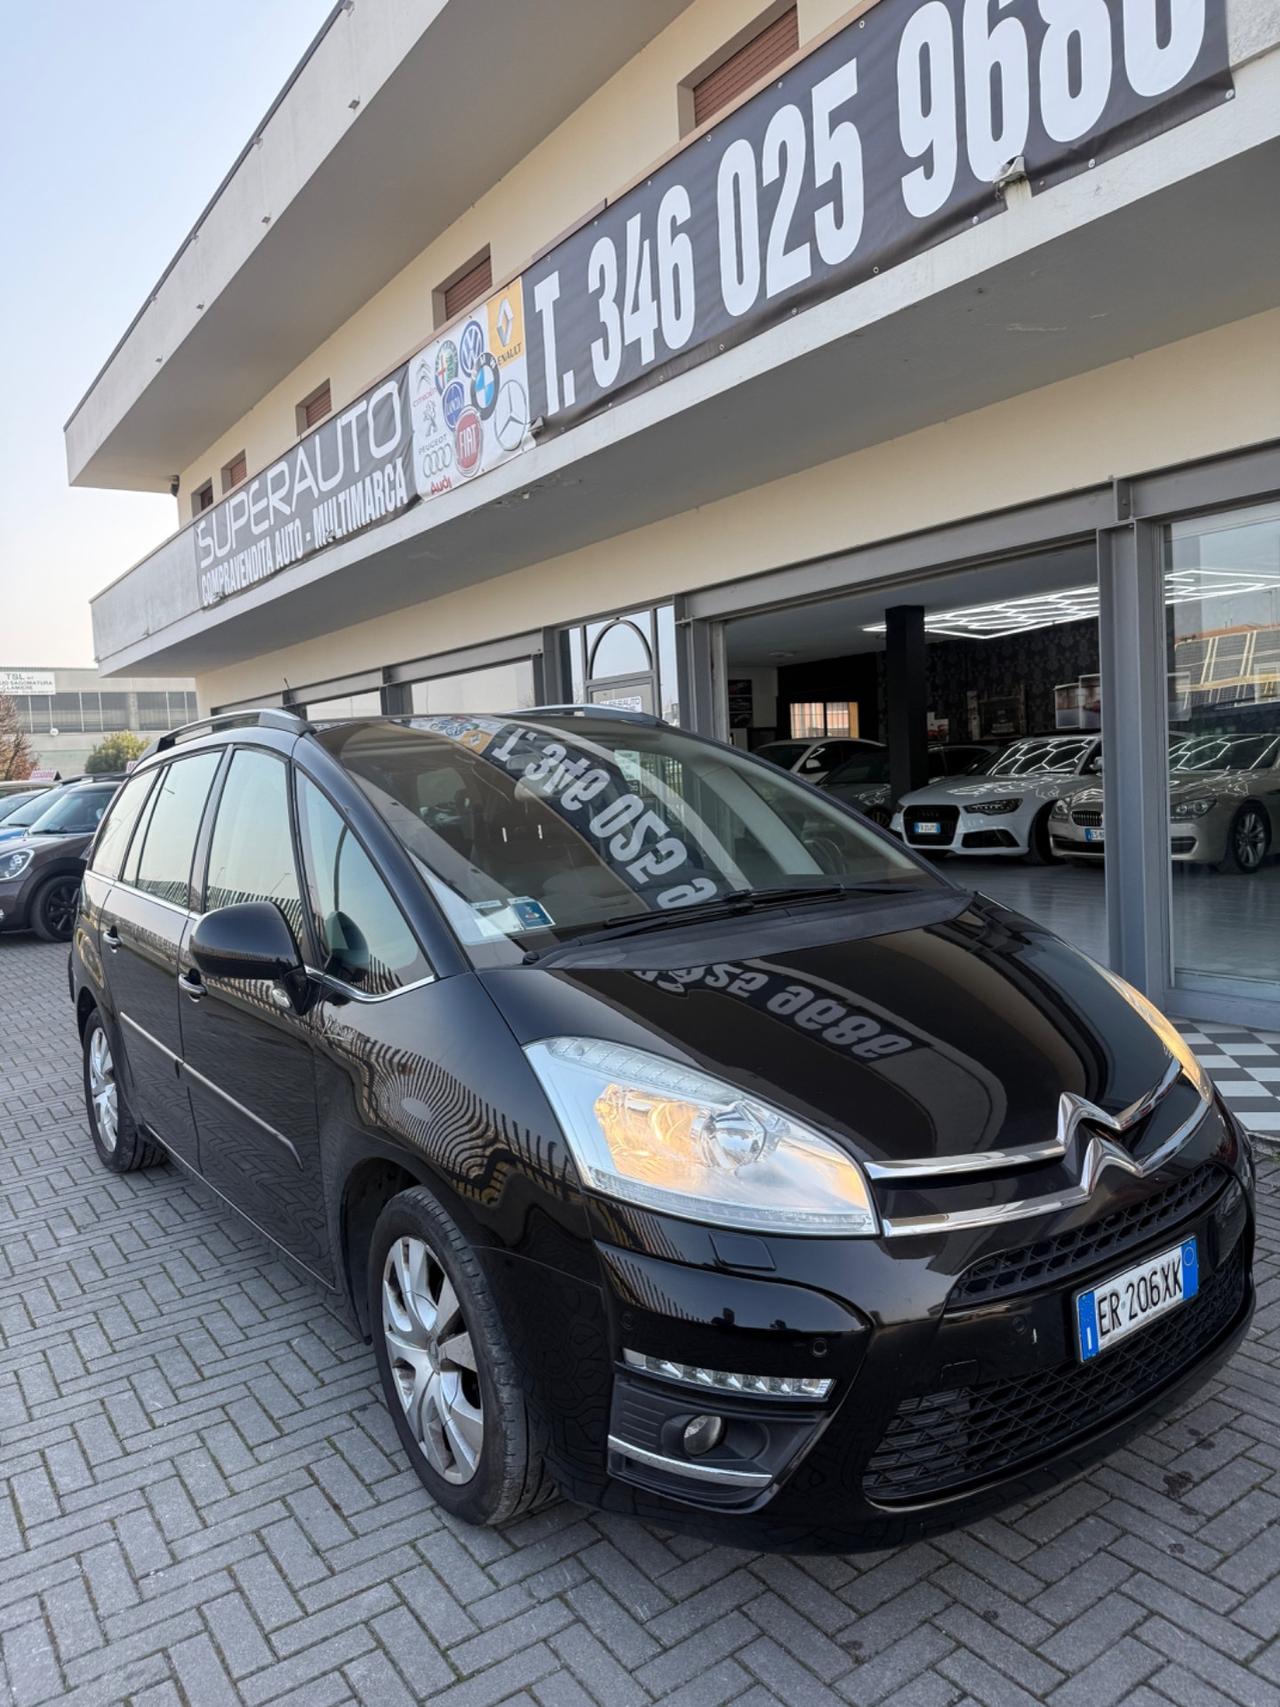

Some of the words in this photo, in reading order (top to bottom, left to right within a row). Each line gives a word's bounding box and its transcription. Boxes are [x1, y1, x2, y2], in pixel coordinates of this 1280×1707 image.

[534, 270, 576, 416] T.
[588, 185, 695, 388] 346
[717, 57, 864, 316] 025
[497, 342, 522, 366] ENAULT
[200, 380, 402, 569] SUPERAUTO
[459, 423, 477, 460] FIAT
[201, 536, 274, 607] COMPRAVENDITA
[274, 518, 304, 576] AUTO
[312, 456, 409, 550] MULTIMARCA
[1097, 1291, 1122, 1337] ER
[1125, 1255, 1183, 1321] 206XK
